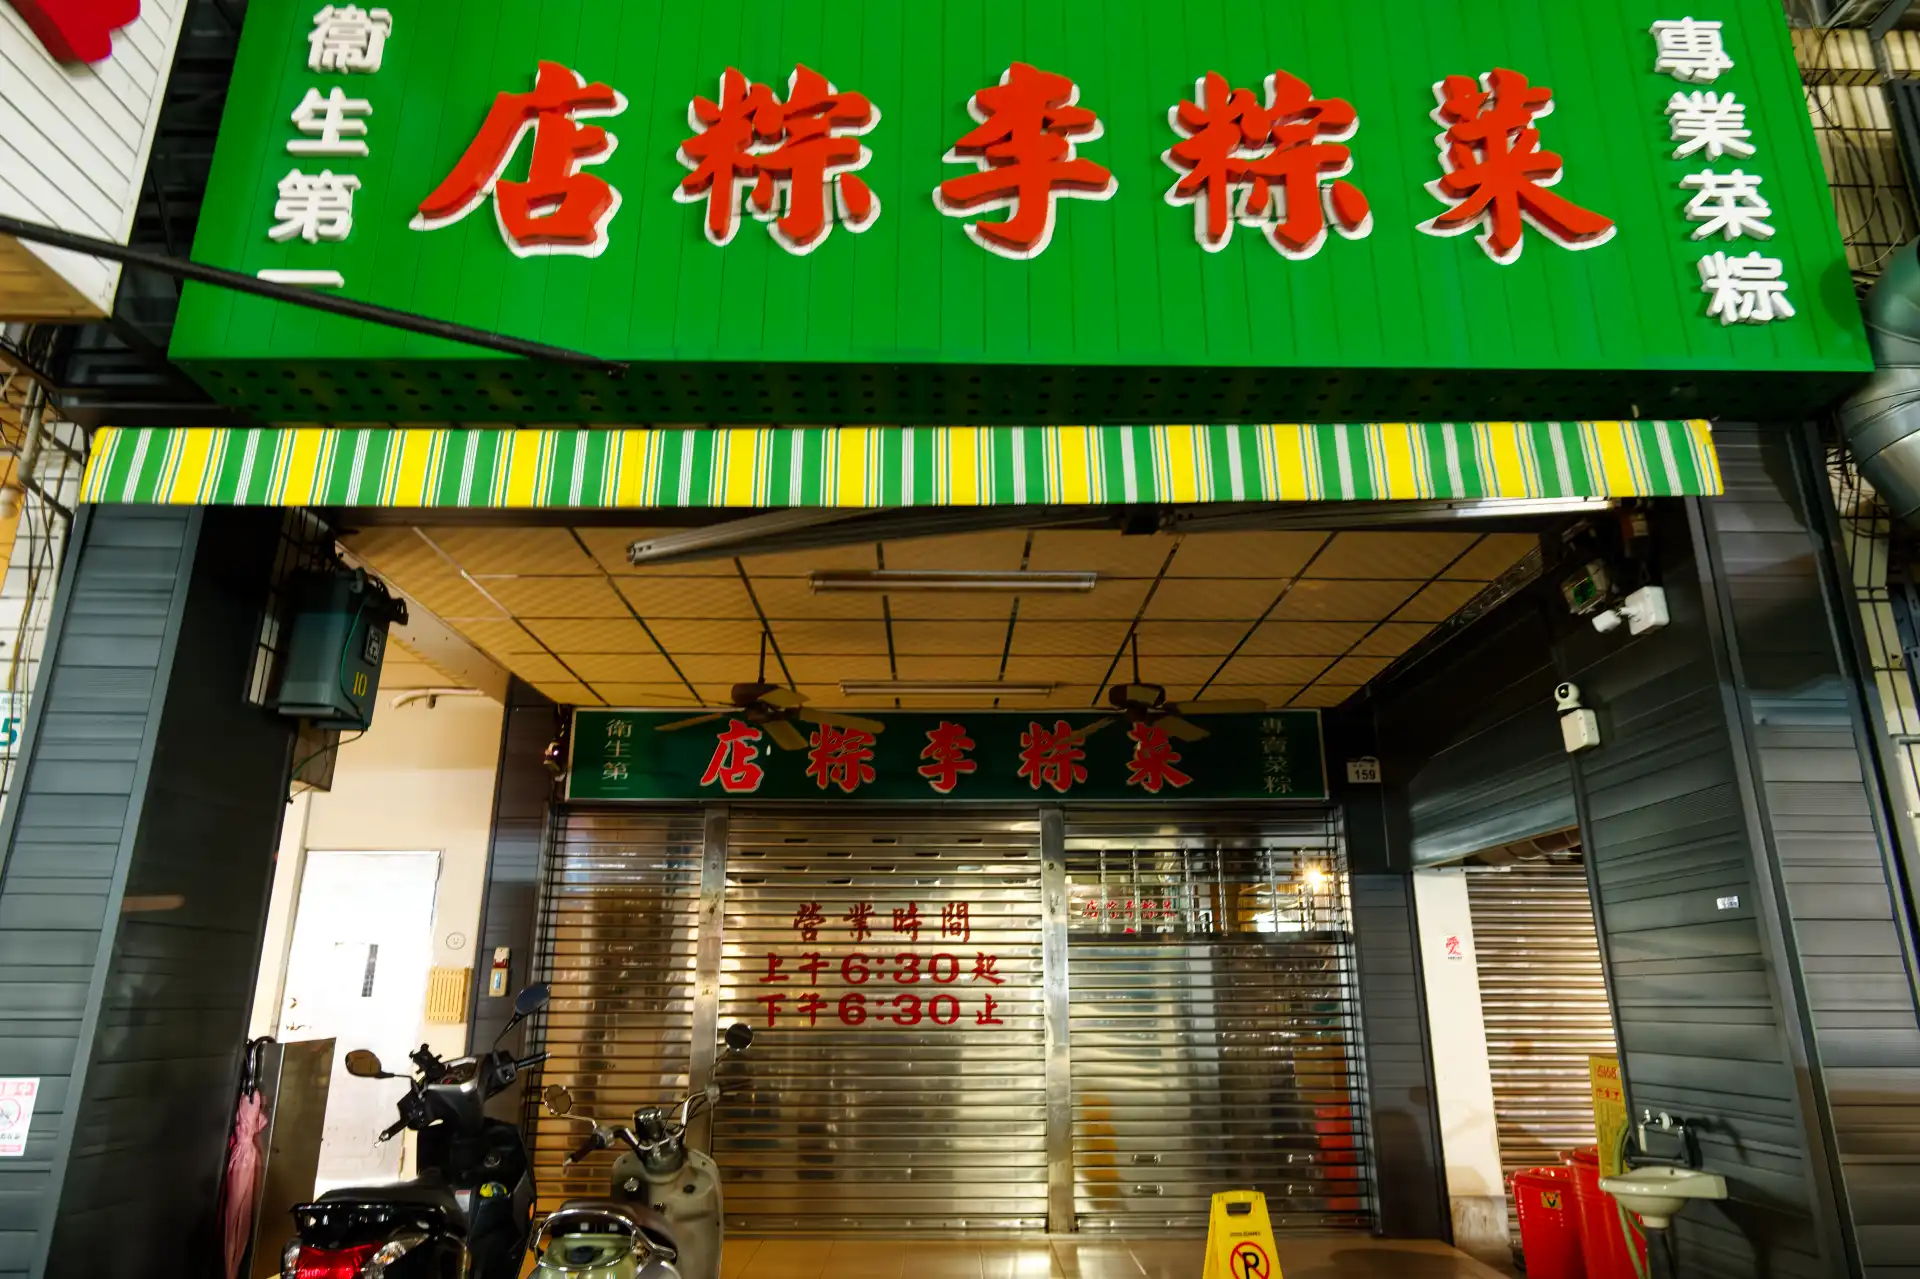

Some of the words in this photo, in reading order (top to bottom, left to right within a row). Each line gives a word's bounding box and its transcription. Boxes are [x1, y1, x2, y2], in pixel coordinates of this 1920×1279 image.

[1649, 16, 1796, 327] 專業菜粽
[1354, 769, 1377, 781] 159
[792, 901, 972, 944] 營業時間
